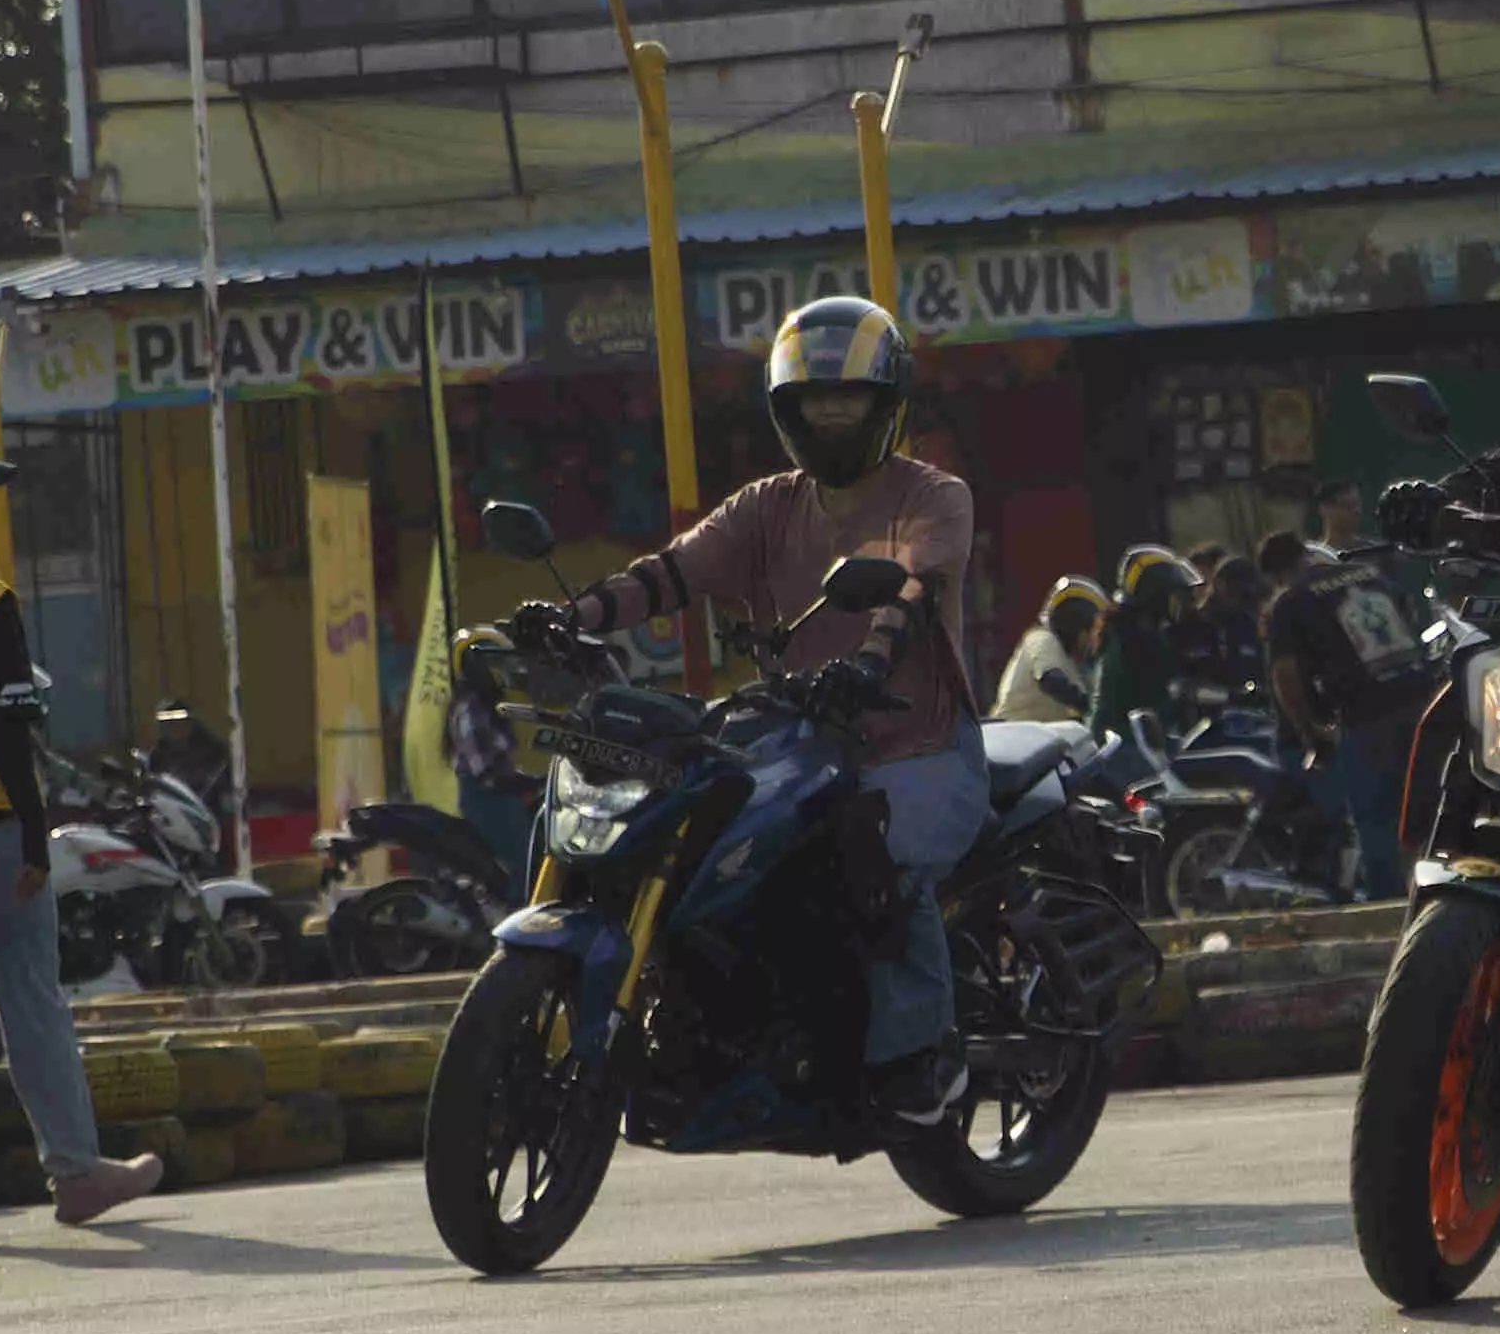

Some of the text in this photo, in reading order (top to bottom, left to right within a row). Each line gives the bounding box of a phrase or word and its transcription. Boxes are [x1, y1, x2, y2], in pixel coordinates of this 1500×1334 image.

[726, 249, 1112, 337] PL & WIN
[134, 298, 516, 386] PLAY & WIN
